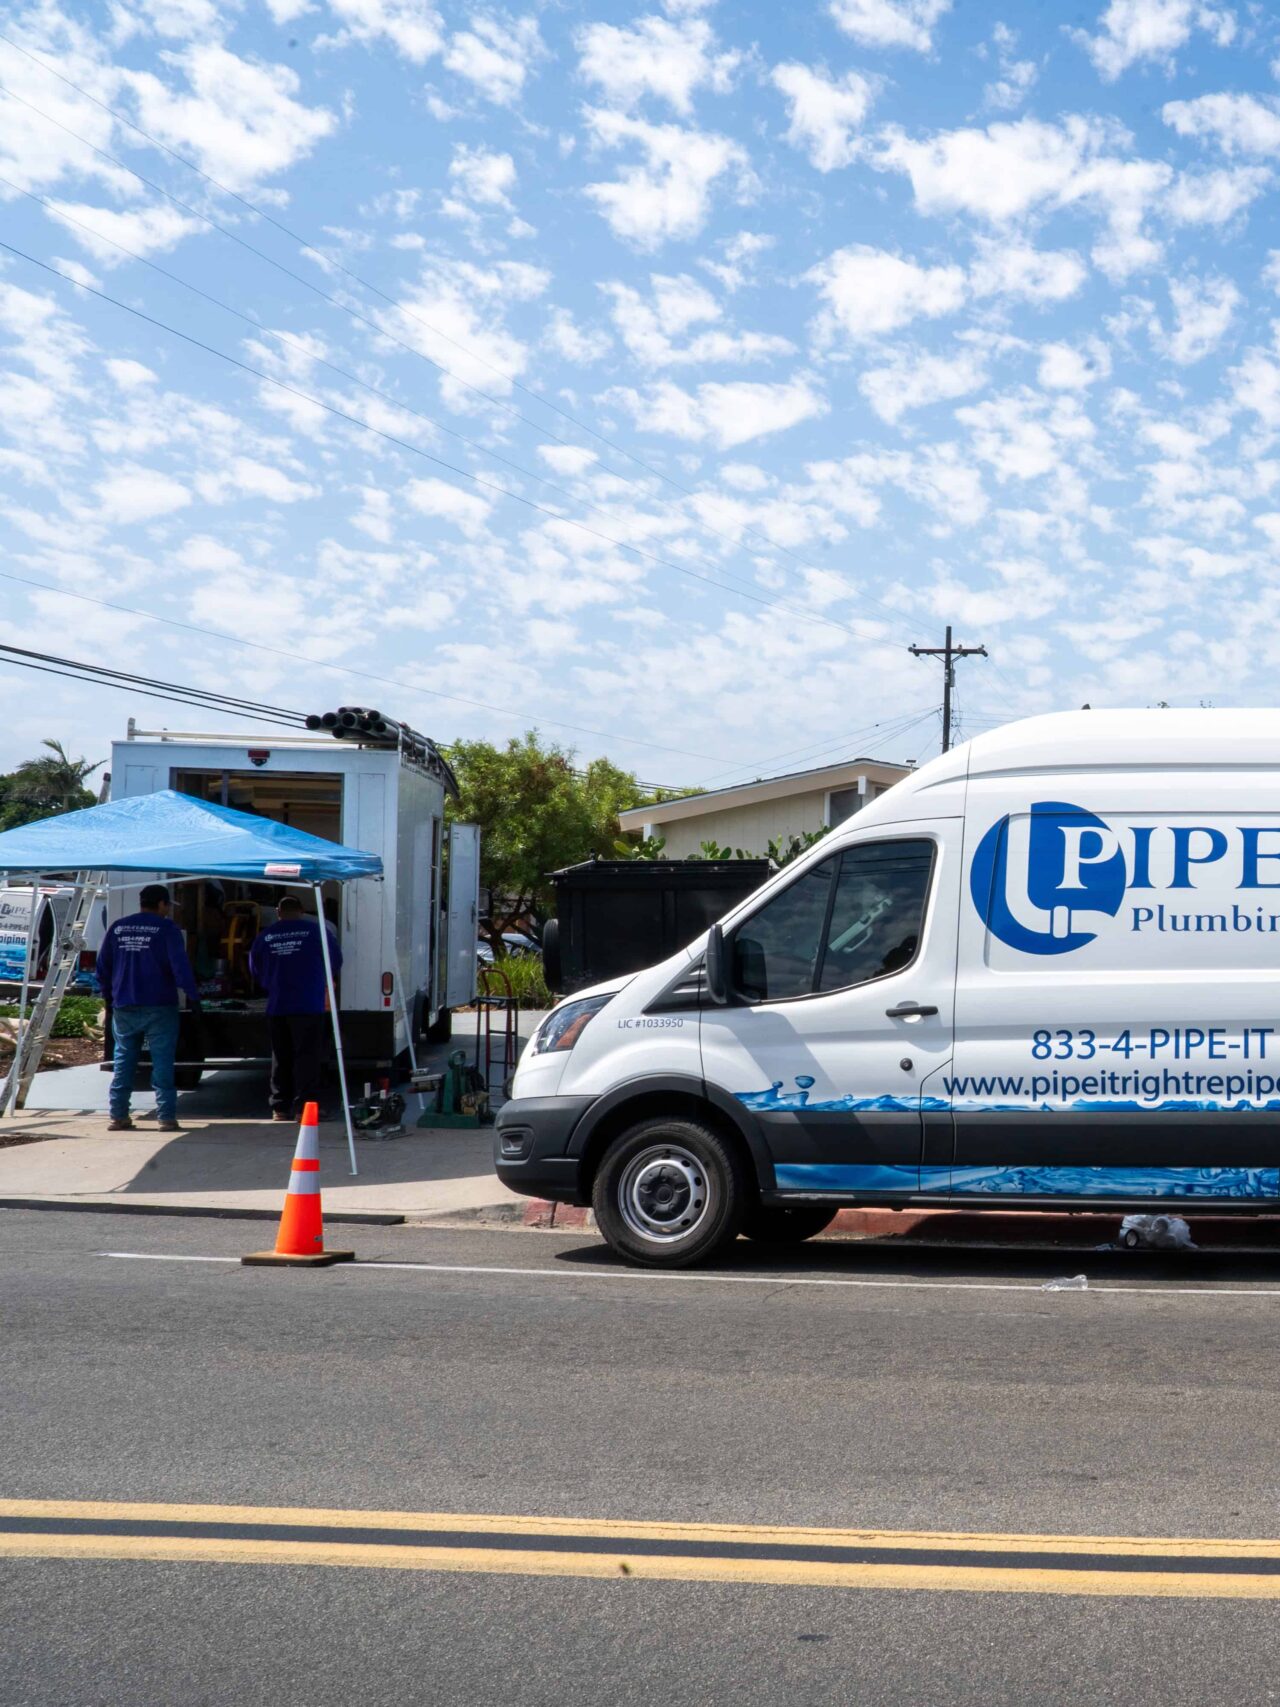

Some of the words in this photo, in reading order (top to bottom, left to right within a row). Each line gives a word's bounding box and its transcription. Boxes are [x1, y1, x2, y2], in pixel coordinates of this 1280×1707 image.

[618, 1019, 633, 1029] LIC
[635, 1018, 684, 1029] #1033950
[1030, 1027, 1275, 1060] 833-4-PIPE-IT
